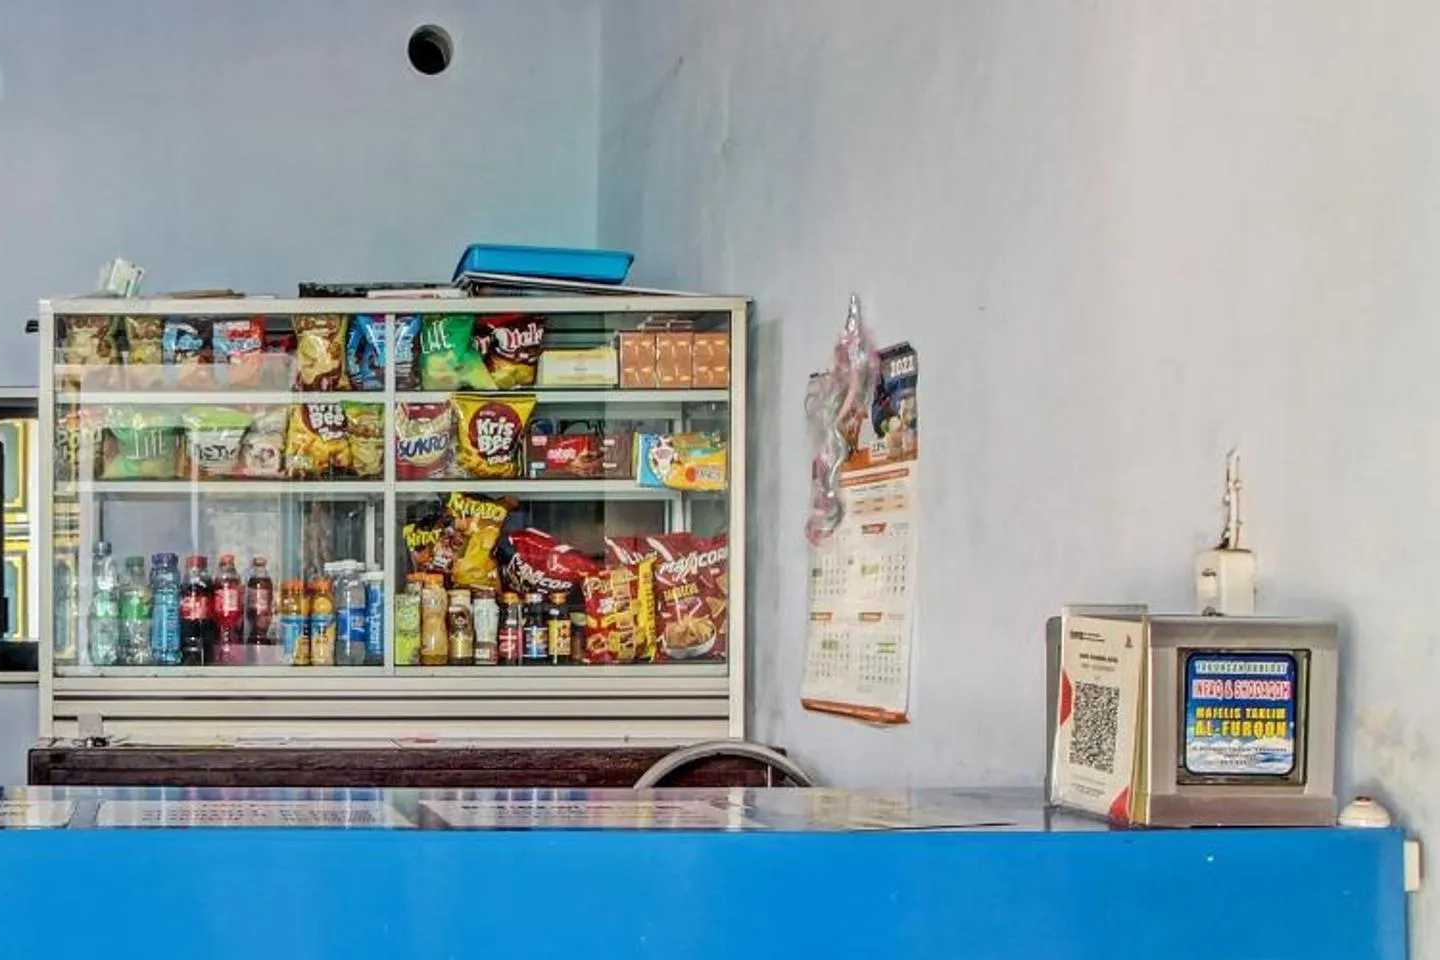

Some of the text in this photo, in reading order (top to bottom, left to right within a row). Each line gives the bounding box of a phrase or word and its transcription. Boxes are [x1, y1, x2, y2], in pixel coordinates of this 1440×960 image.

[889, 355, 915, 377] 2022
[476, 416, 515, 437] Kris
[398, 432, 450, 459] SUKRO
